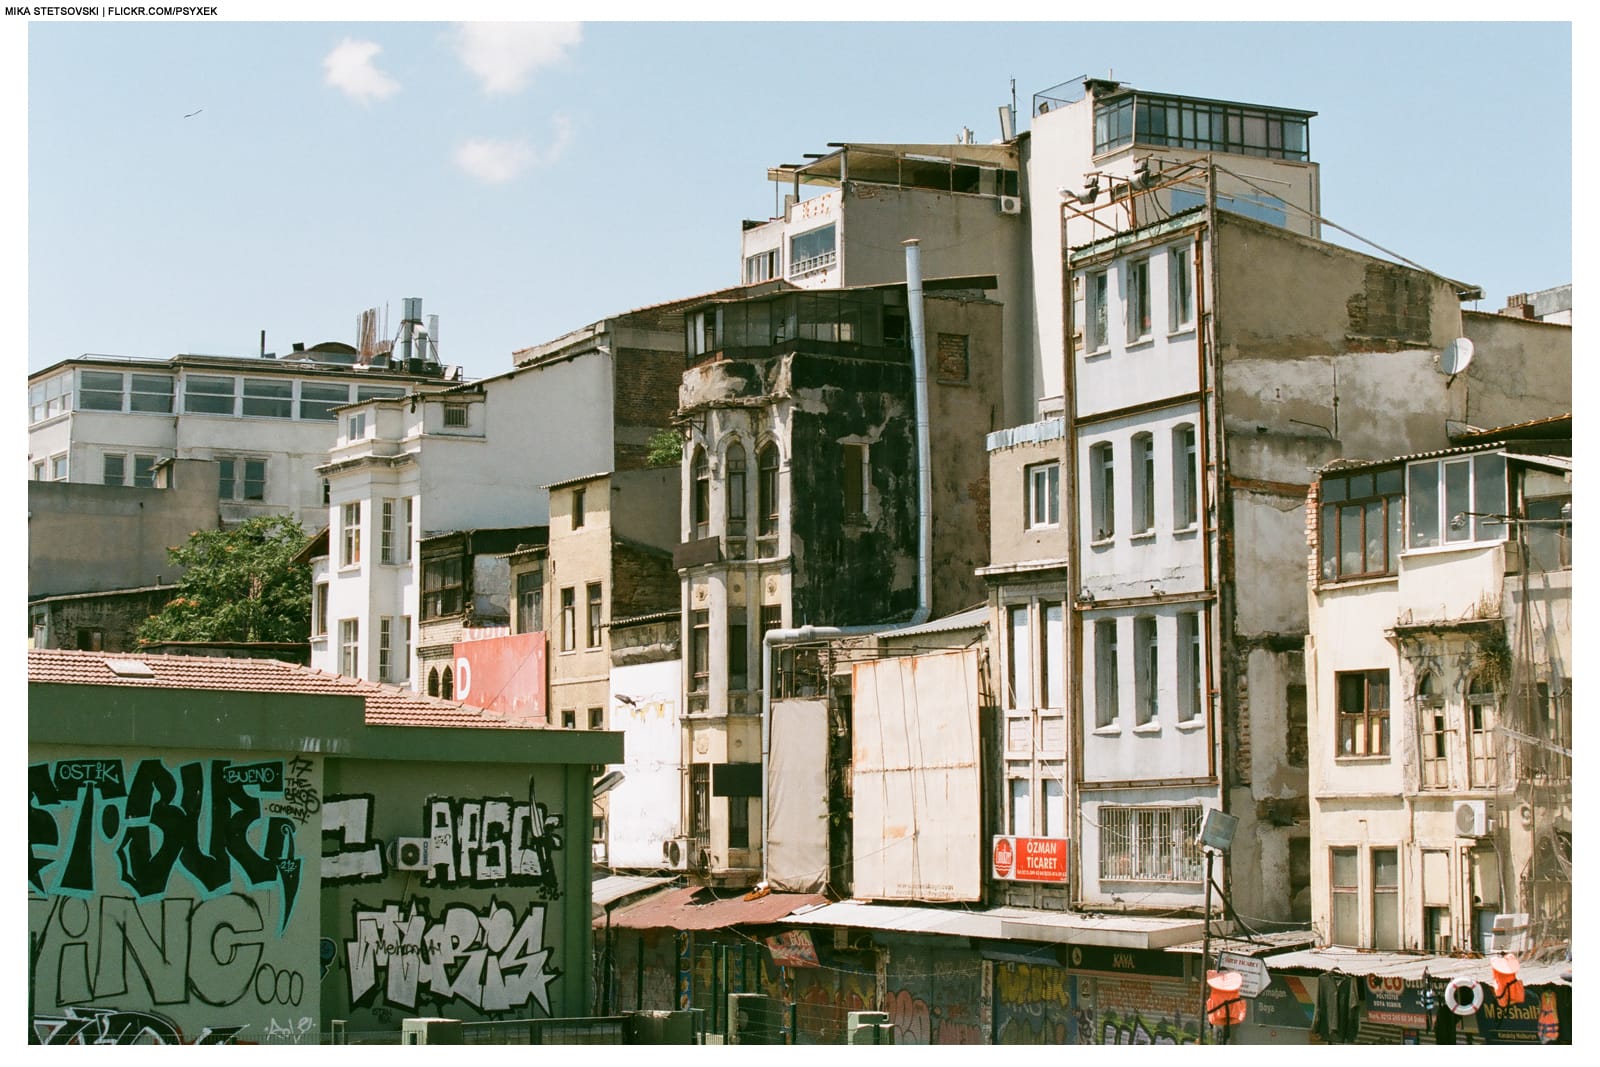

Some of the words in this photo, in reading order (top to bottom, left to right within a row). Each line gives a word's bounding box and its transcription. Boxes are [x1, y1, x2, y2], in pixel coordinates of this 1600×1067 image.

[456, 656, 472, 701] D
[1026, 839, 1057, 854] ÖZMAN
[1026, 854, 1058, 869] TİCARET
[1112, 953, 1136, 968] KAYA
